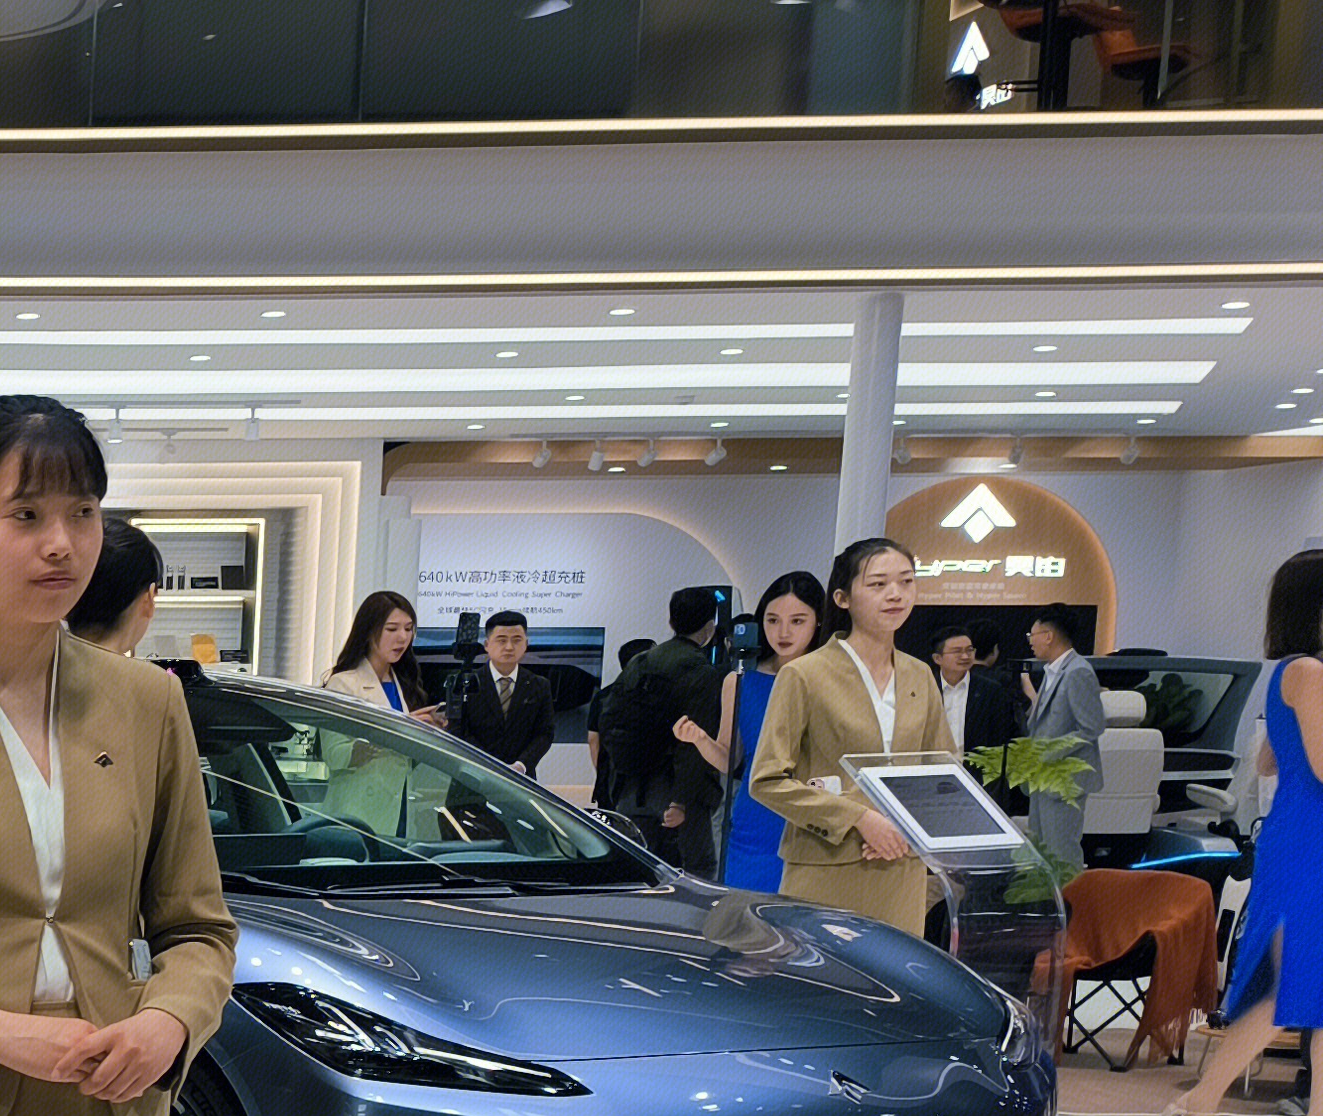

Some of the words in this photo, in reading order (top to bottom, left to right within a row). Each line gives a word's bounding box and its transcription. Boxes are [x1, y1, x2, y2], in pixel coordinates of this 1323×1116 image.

[476, 590, 498, 599] Liquid
[502, 590, 529, 599] Cooling
[531, 590, 552, 599] Super
[555, 590, 583, 599] Charger
